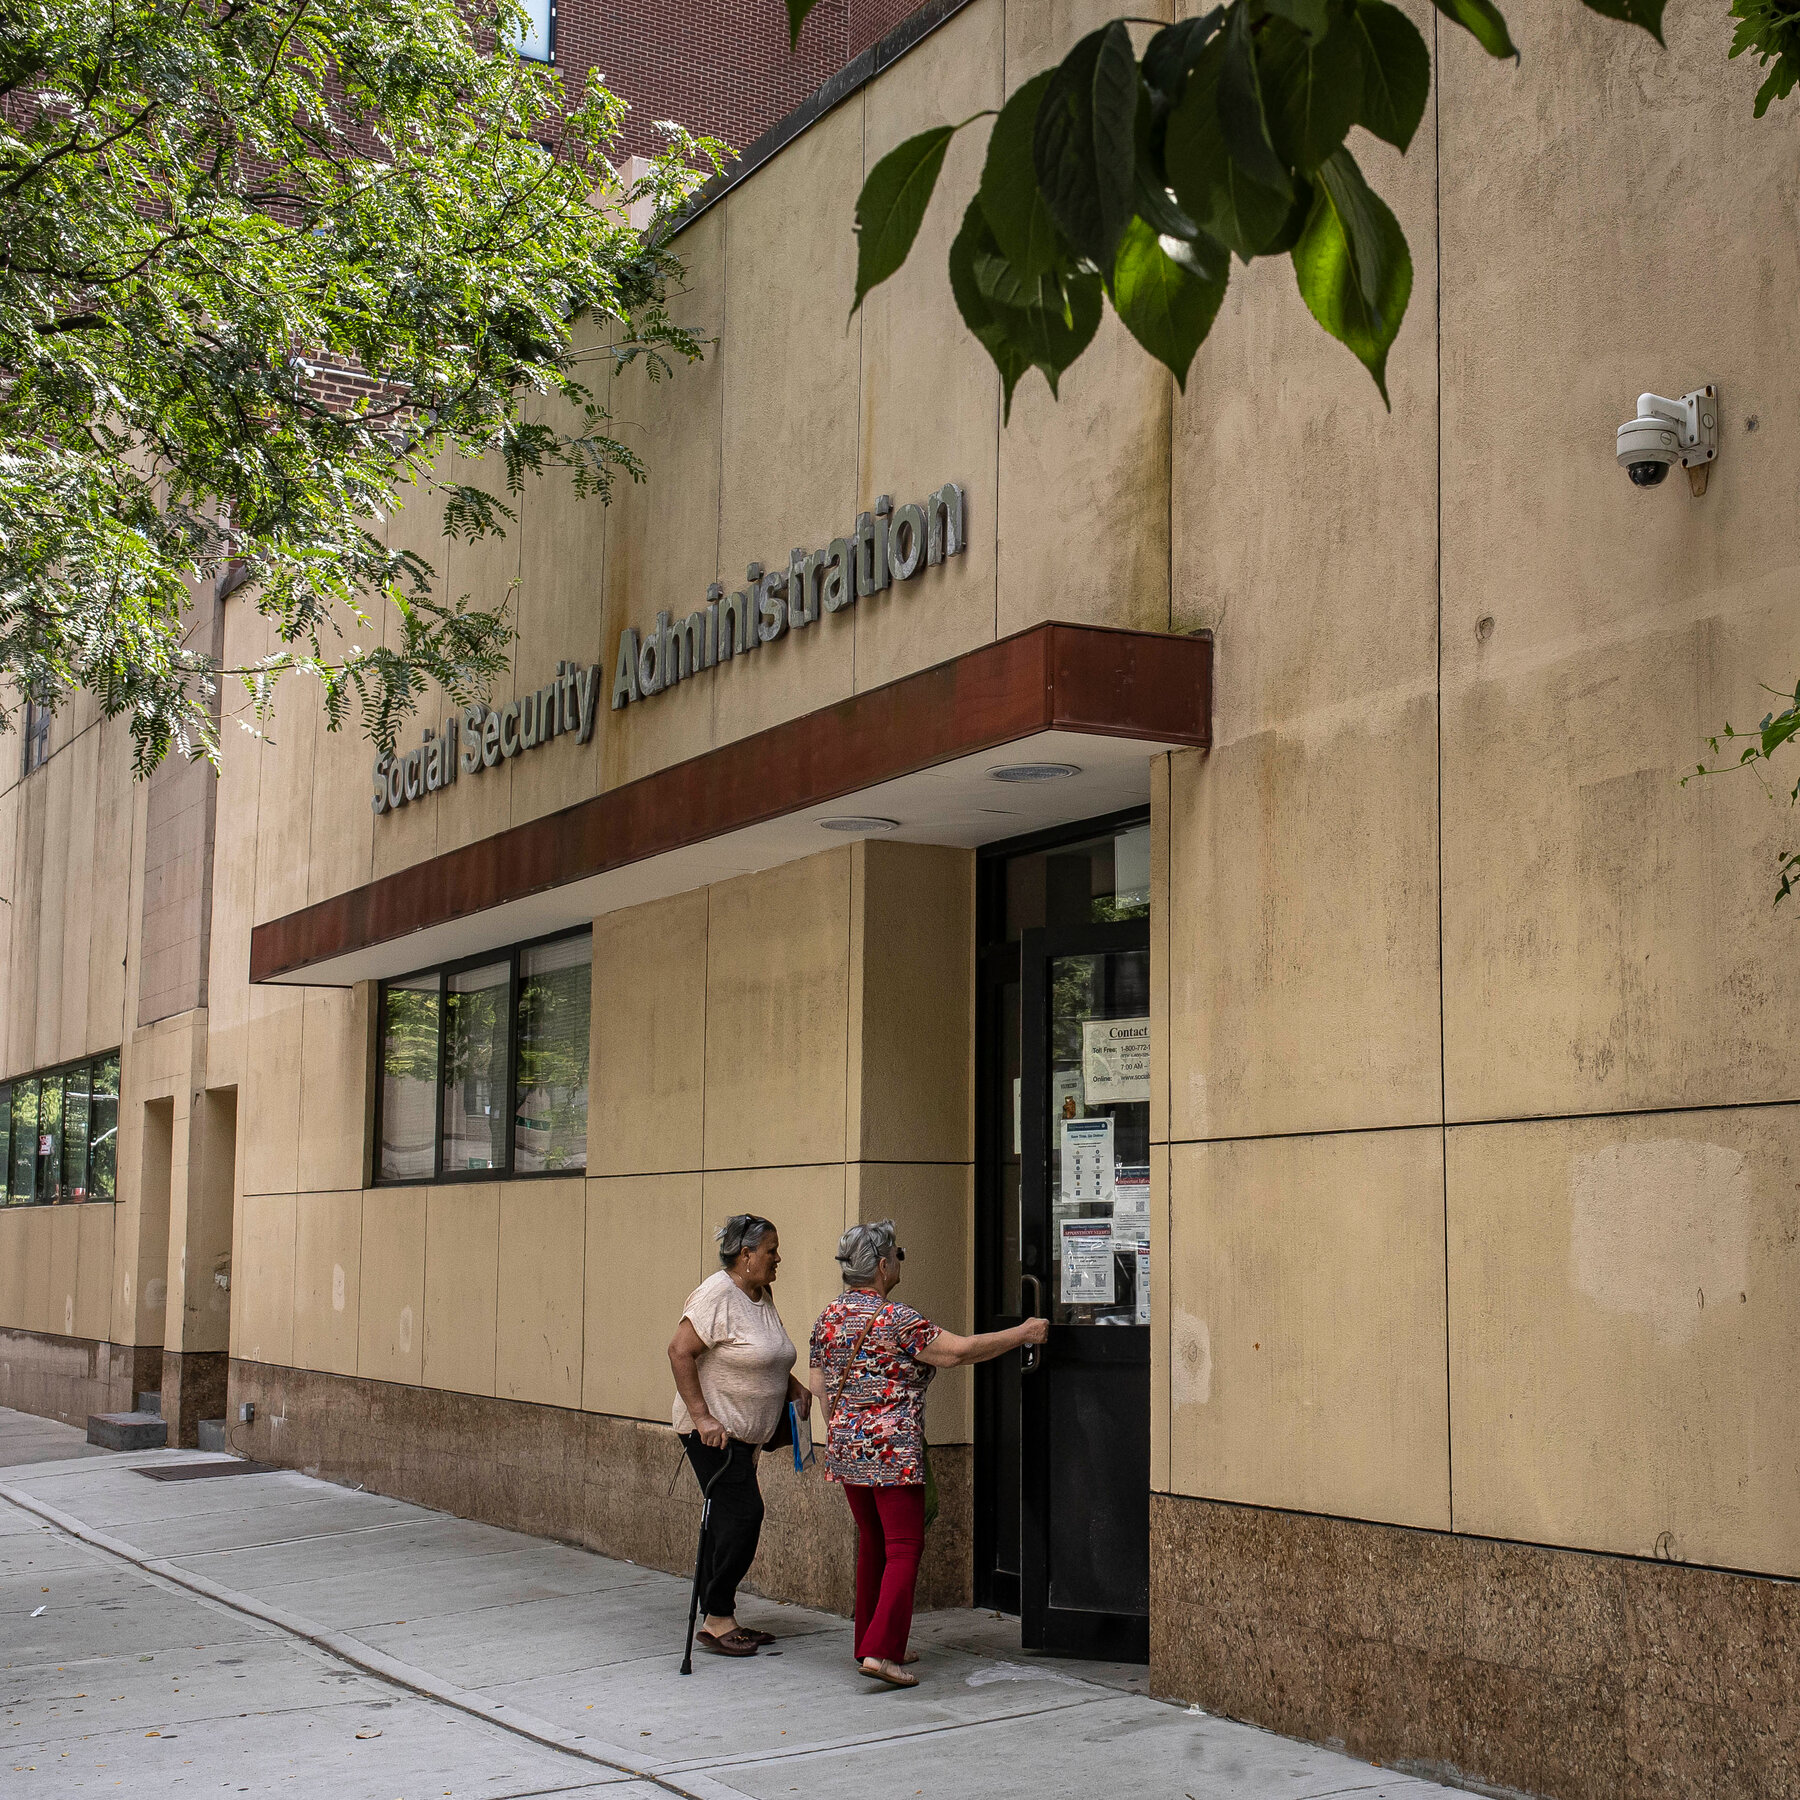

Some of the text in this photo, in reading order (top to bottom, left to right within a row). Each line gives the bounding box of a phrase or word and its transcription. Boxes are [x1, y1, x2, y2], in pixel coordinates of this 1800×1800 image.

[371, 482, 965, 815] Social Security Administration
[1109, 1027, 1148, 1038] Contact
